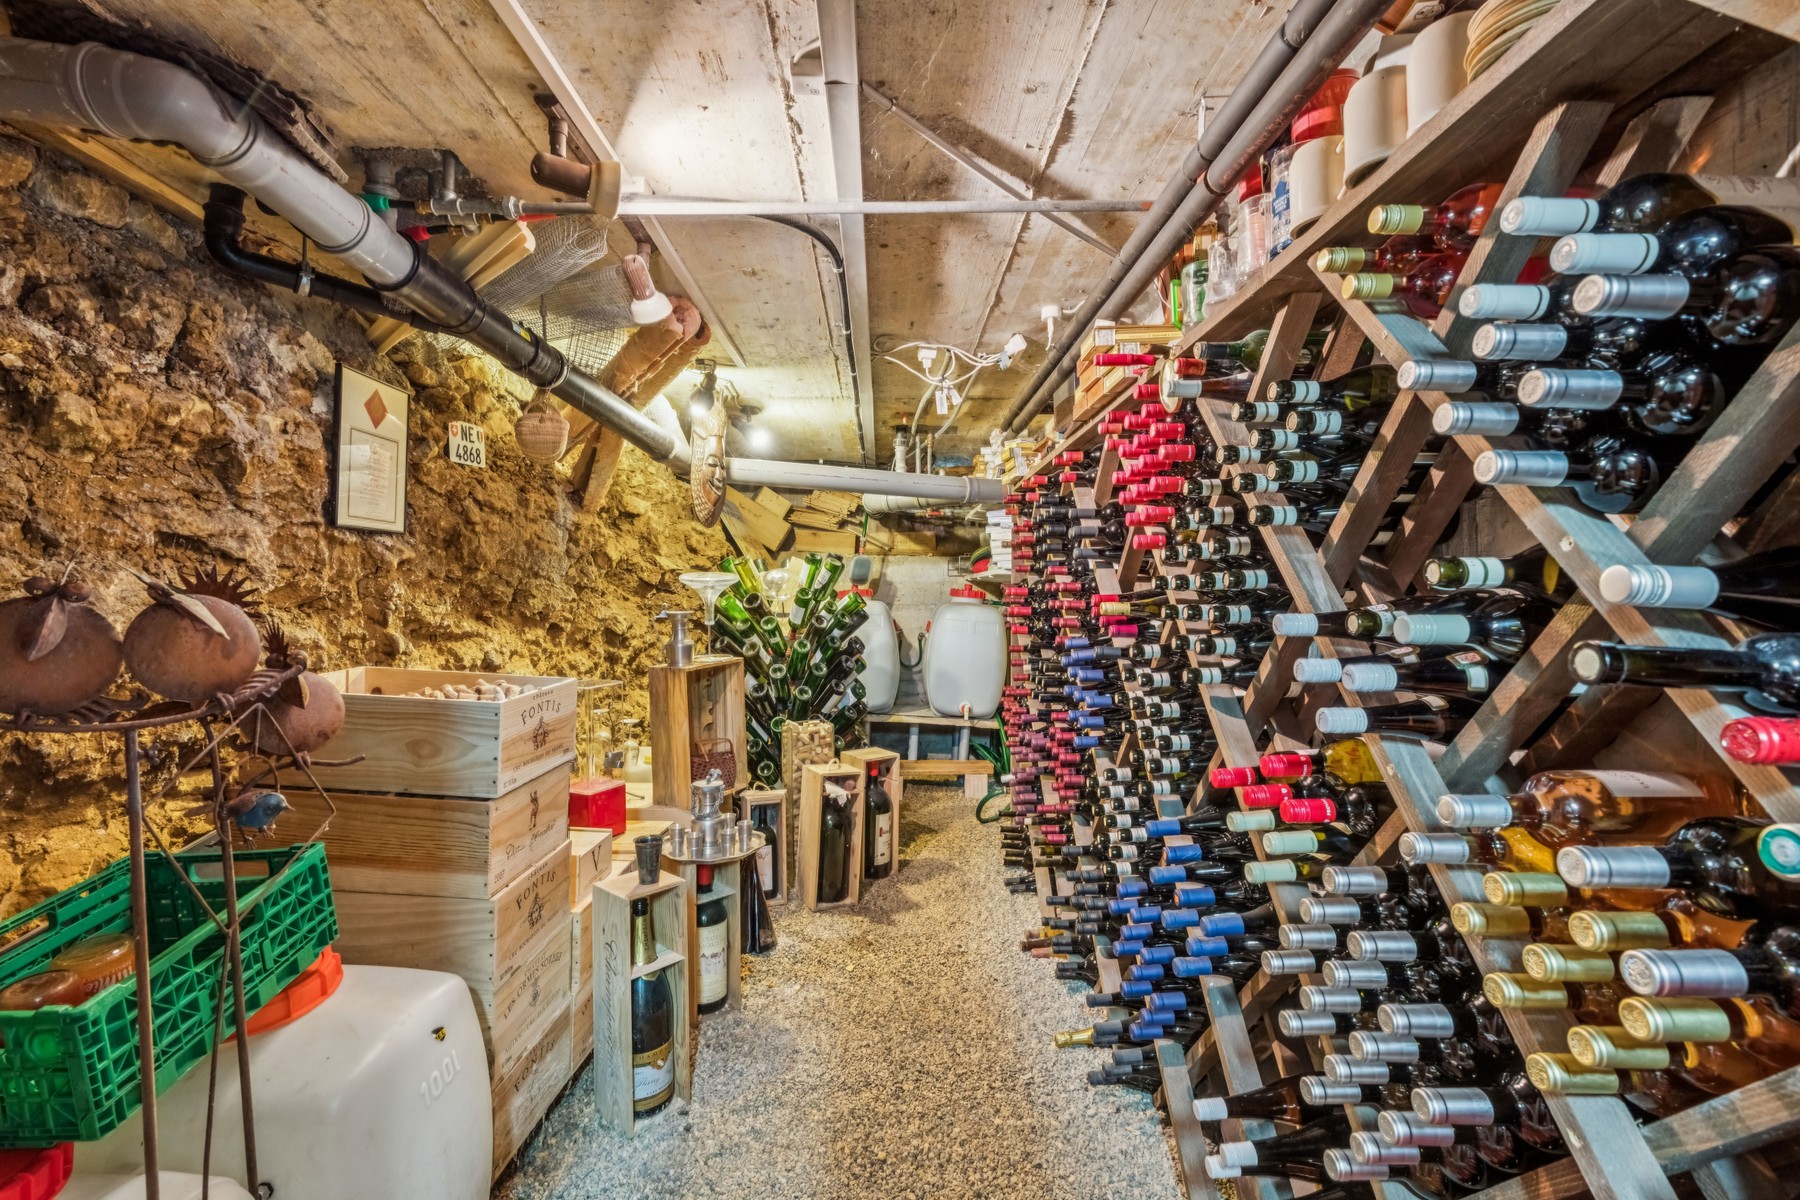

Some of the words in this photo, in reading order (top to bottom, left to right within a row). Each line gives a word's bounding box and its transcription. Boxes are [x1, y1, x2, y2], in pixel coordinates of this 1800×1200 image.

[461, 424, 475, 443] NE
[456, 444, 481, 465] 4868
[521, 700, 561, 726] FONTIS
[592, 845, 601, 872] V
[516, 871, 556, 910] FONTIS
[504, 997, 516, 1020] LES
[514, 1039, 556, 1092] FONTIS
